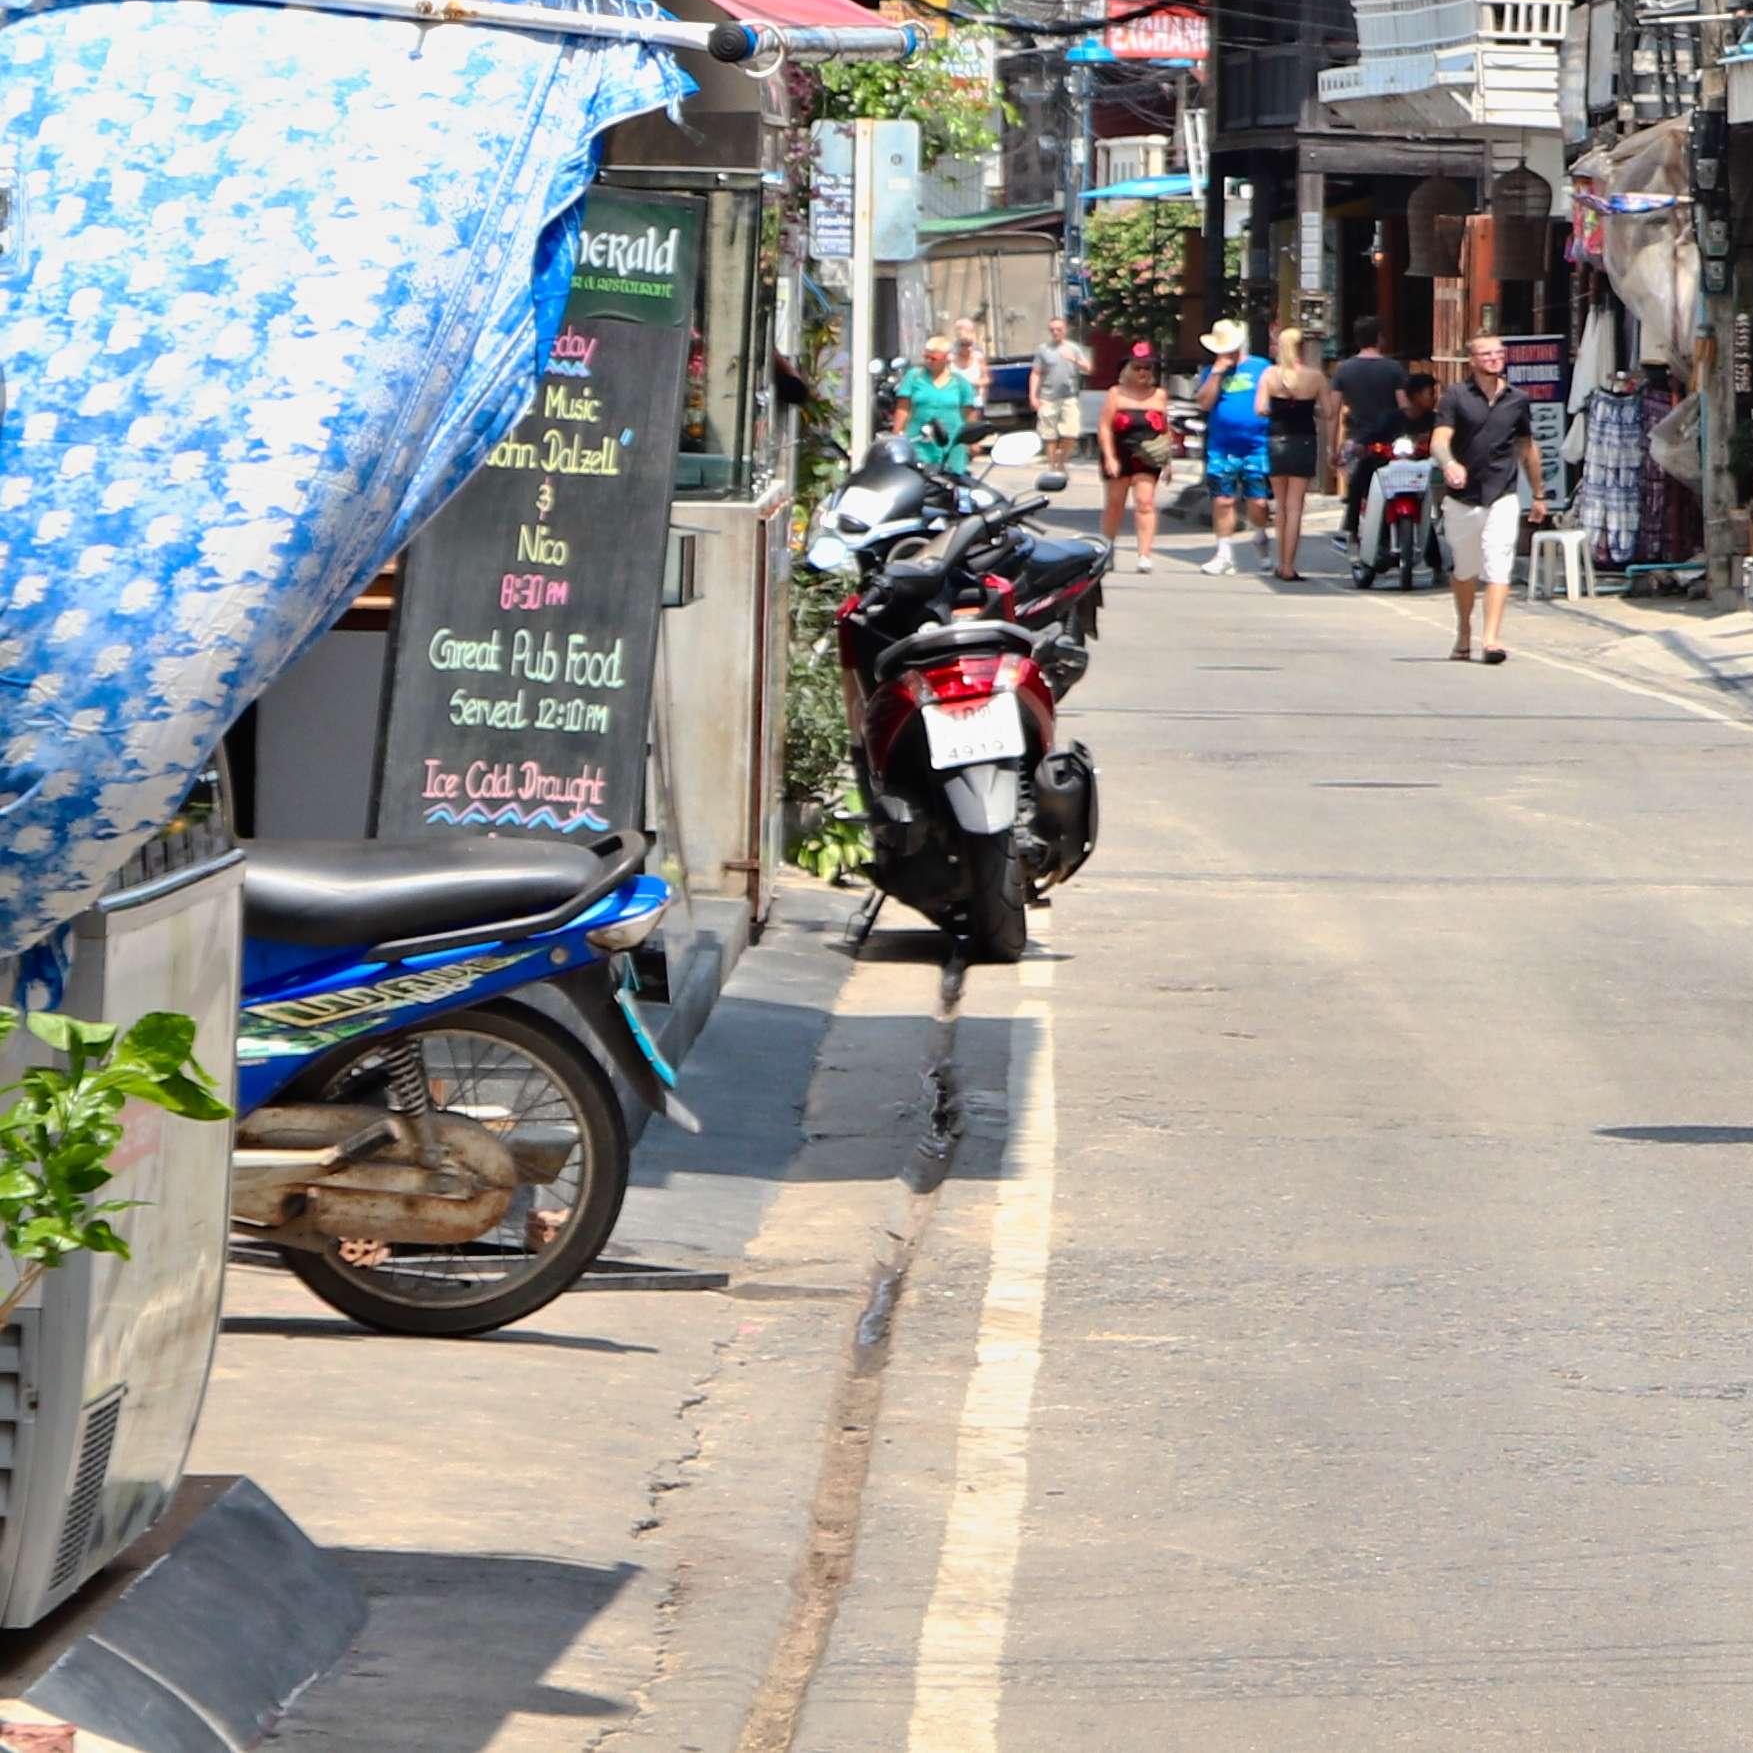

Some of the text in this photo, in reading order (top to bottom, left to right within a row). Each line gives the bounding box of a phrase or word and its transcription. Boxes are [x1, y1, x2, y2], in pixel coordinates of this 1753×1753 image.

[544, 385, 600, 422] Music
[517, 524, 569, 566] Nico
[501, 573, 570, 610] 8:30 PM
[429, 628, 625, 689] Great Pub Food
[450, 688, 529, 730] Served
[422, 758, 460, 799] Ice
[518, 761, 607, 819] Draught
